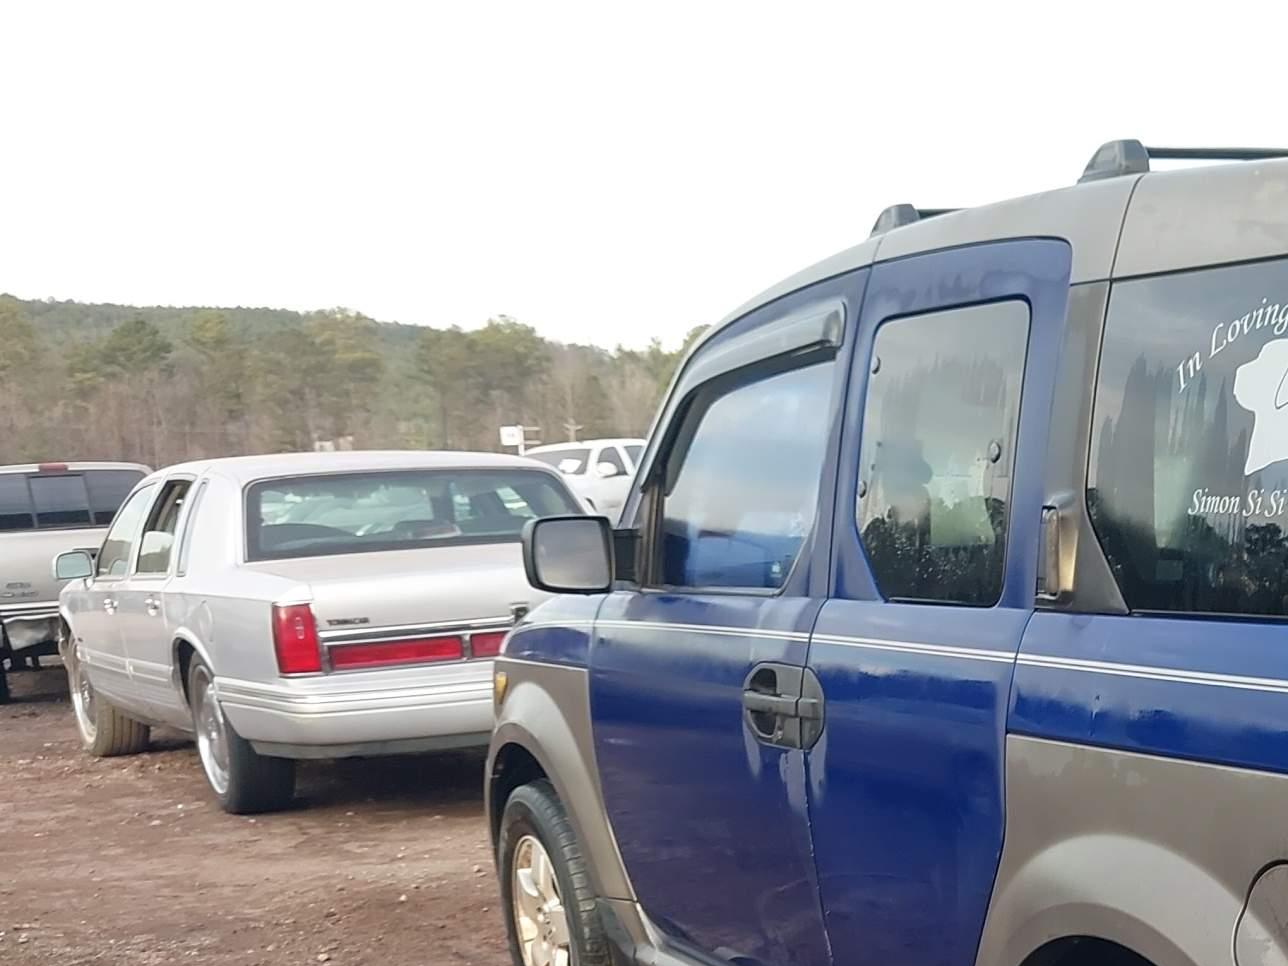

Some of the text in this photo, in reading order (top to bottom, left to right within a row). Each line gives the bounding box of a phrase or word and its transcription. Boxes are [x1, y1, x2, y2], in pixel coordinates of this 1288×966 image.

[1176, 352, 1202, 393] In
[1188, 488, 1240, 515] Simon
[1242, 489, 1265, 517] Si
[1264, 490, 1285, 518] Si
